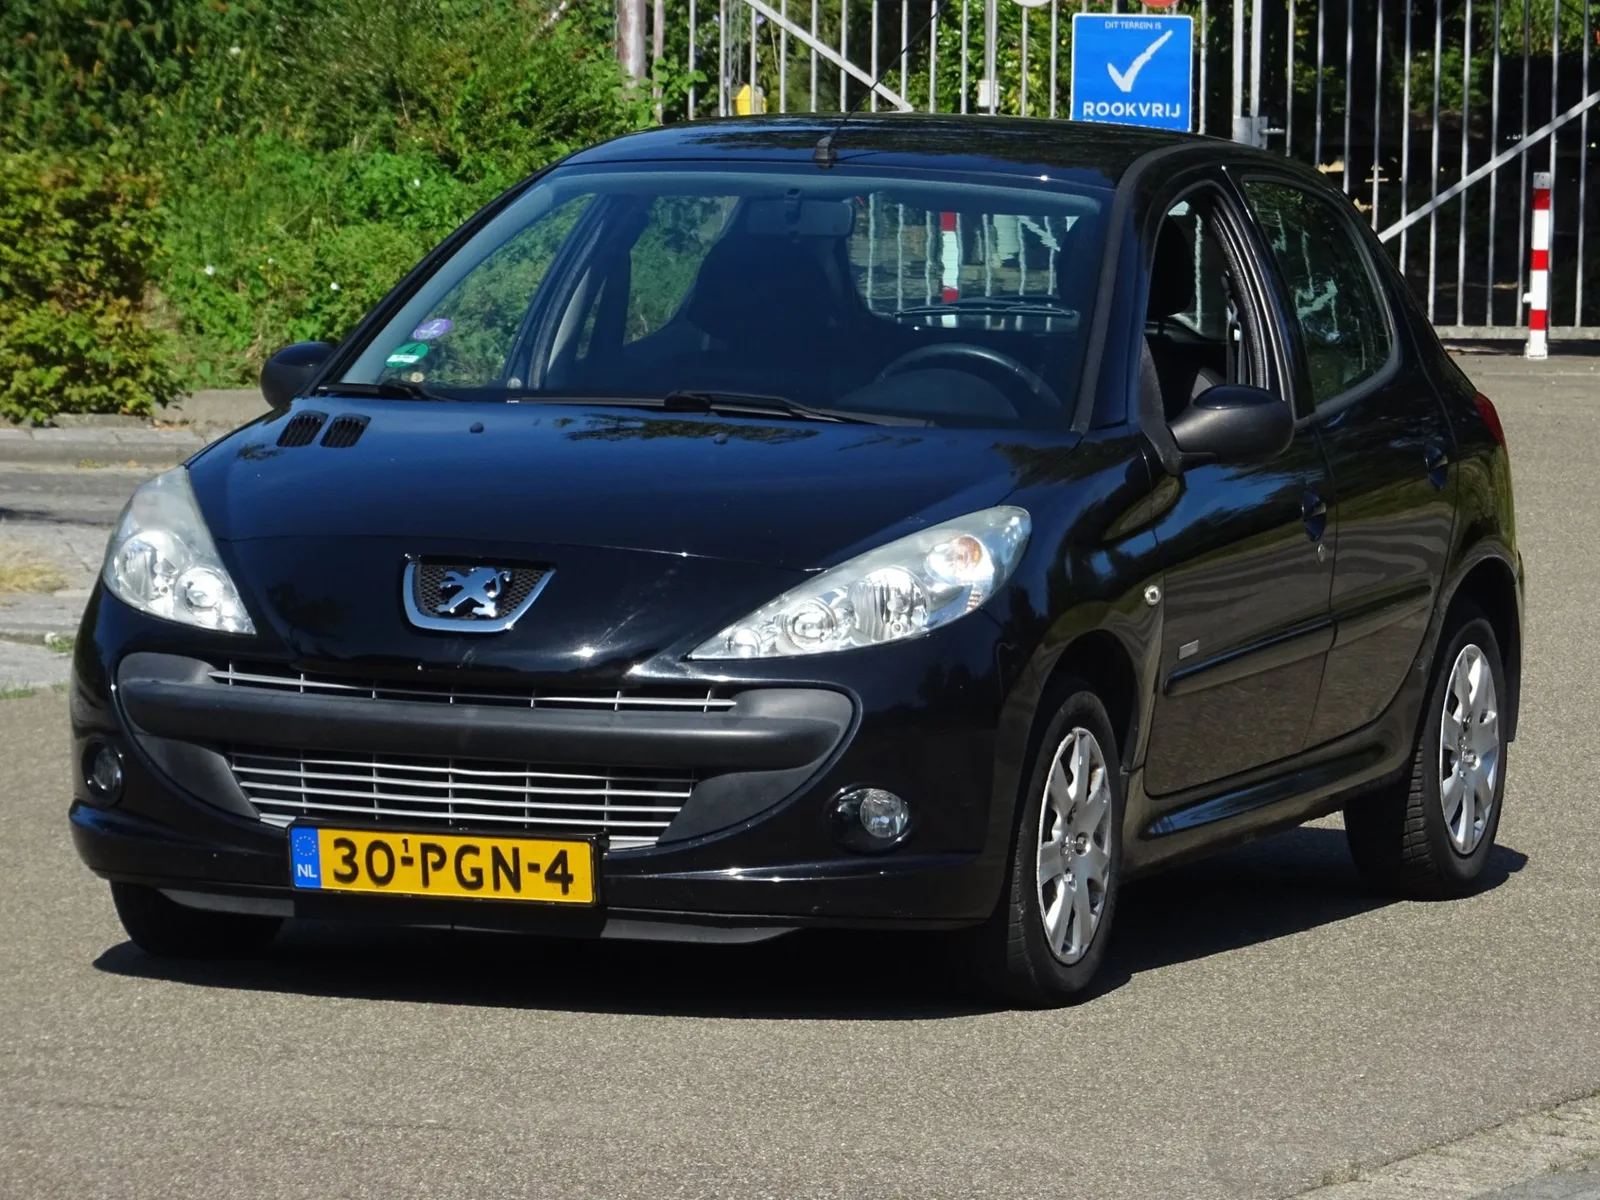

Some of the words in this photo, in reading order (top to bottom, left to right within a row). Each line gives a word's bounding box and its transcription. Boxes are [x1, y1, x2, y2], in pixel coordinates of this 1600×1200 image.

[1104, 21, 1118, 29] DIT
[1120, 21, 1153, 30] TERREIN
[1154, 22, 1162, 30] IS
[1082, 102, 1181, 118] ROOKVRIJ
[297, 863, 317, 878] NL
[333, 837, 575, 896] 30-PGN-4
